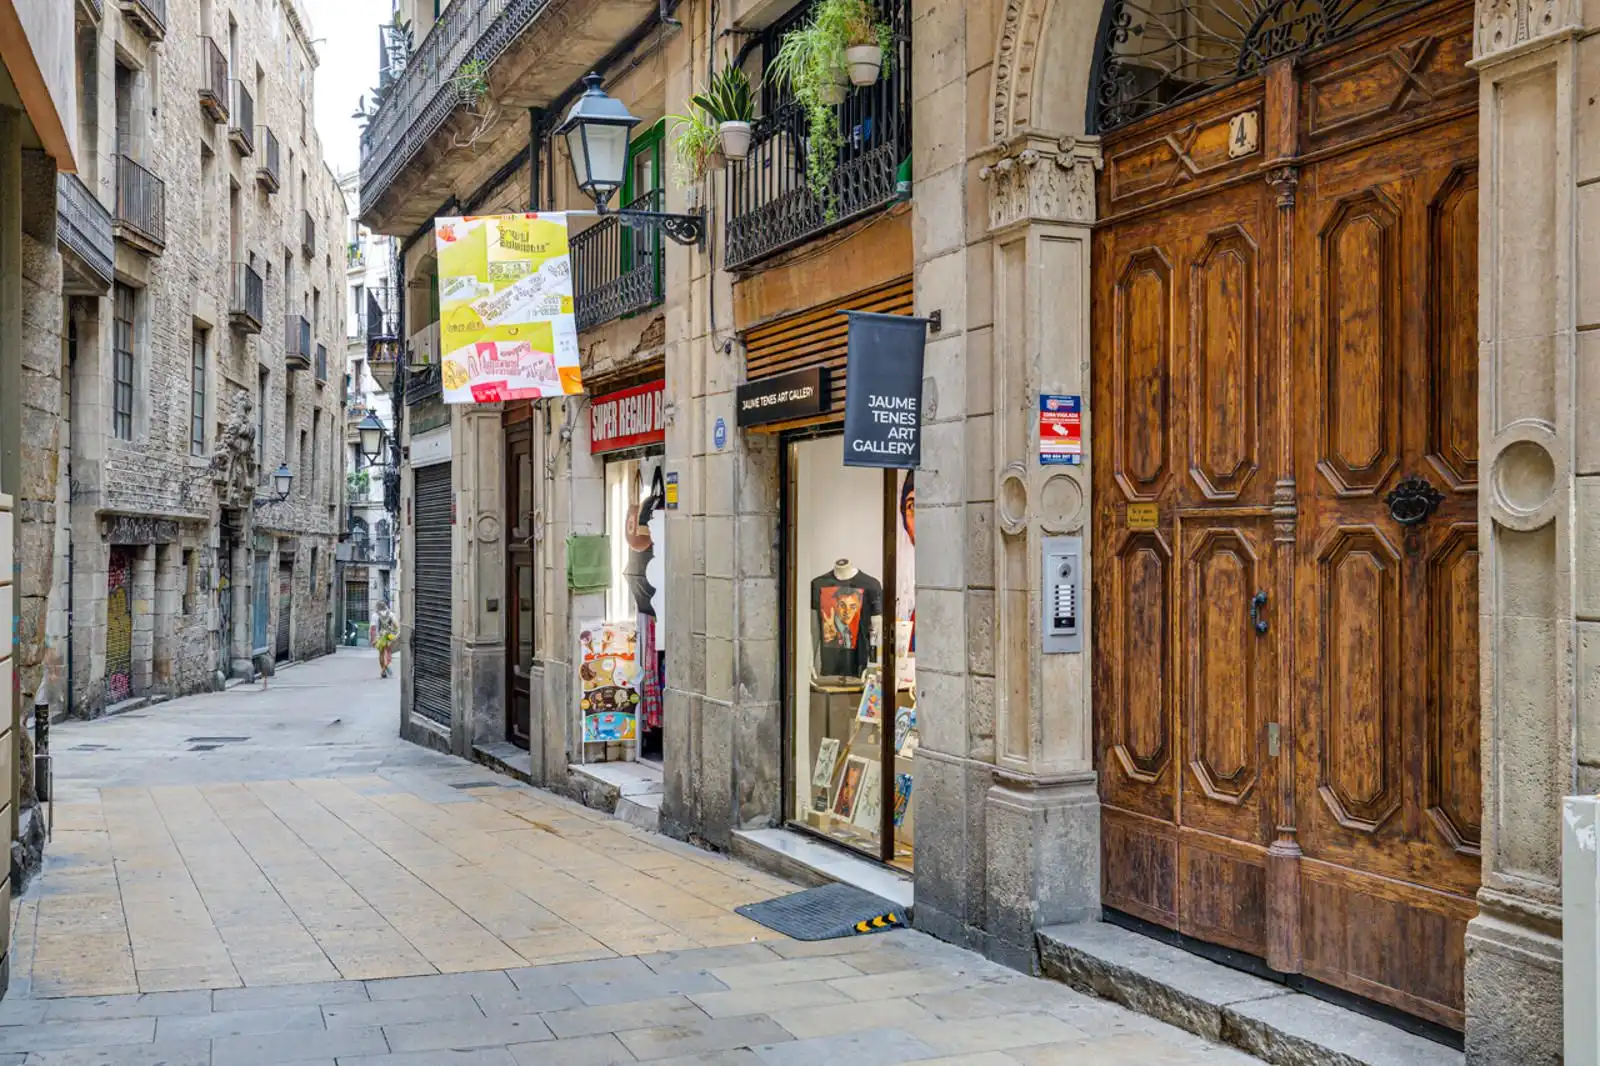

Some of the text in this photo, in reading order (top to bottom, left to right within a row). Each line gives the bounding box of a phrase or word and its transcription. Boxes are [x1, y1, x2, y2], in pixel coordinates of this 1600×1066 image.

[1235, 117, 1247, 147] 4
[742, 386, 814, 410] JAUME TENES ART GALLERY
[868, 395, 916, 411] JAUME
[592, 400, 617, 441] SUPER
[619, 392, 652, 436] REGALO
[872, 410, 916, 425] TENES
[887, 427, 916, 439] ART
[852, 440, 916, 456] GALLERY
